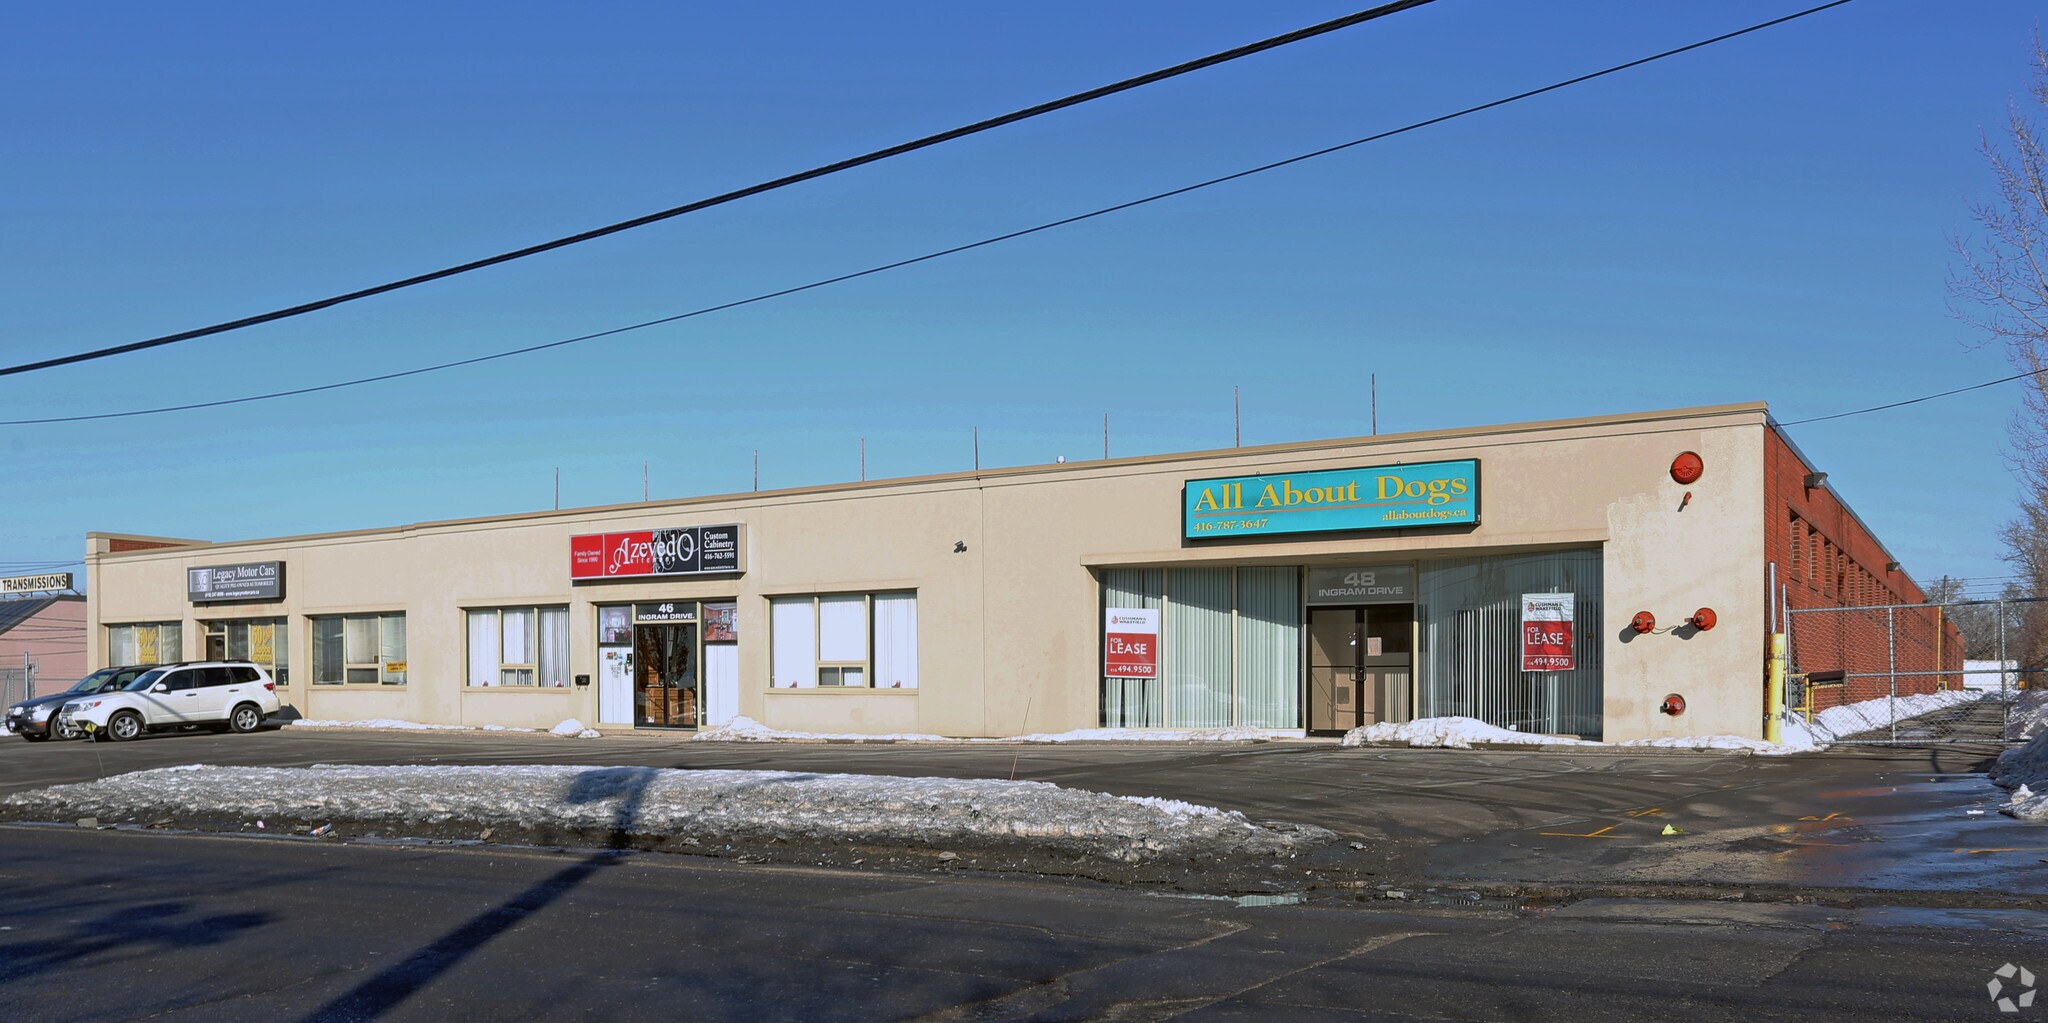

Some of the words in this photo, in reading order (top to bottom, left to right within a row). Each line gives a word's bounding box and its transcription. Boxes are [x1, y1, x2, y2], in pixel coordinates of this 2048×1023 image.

[1193, 482, 1242, 511] All
[1255, 479, 1361, 507] About
[1376, 475, 1468, 505] Dogs
[1382, 507, 1467, 522] allaboutdogs.ca
[1193, 518, 1269, 532] 416-787-3647
[704, 531, 728, 540] Custom
[704, 540, 734, 550] Cabinetry
[213, 567, 236, 582] Legacy
[237, 566, 258, 578] Motor
[259, 563, 275, 576] Cars
[3, 575, 66, 591] TRANSMISSIONS
[1344, 572, 1376, 586] 48
[1318, 588, 1366, 597] INGRAM
[1368, 587, 1404, 595] DRIVE
[658, 603, 674, 613] 46
[1527, 632, 1564, 645] LEASE
[1110, 643, 1147, 655] LEASE
[1534, 657, 1569, 666] 494.9500
[1118, 665, 1152, 674] 494.9500
